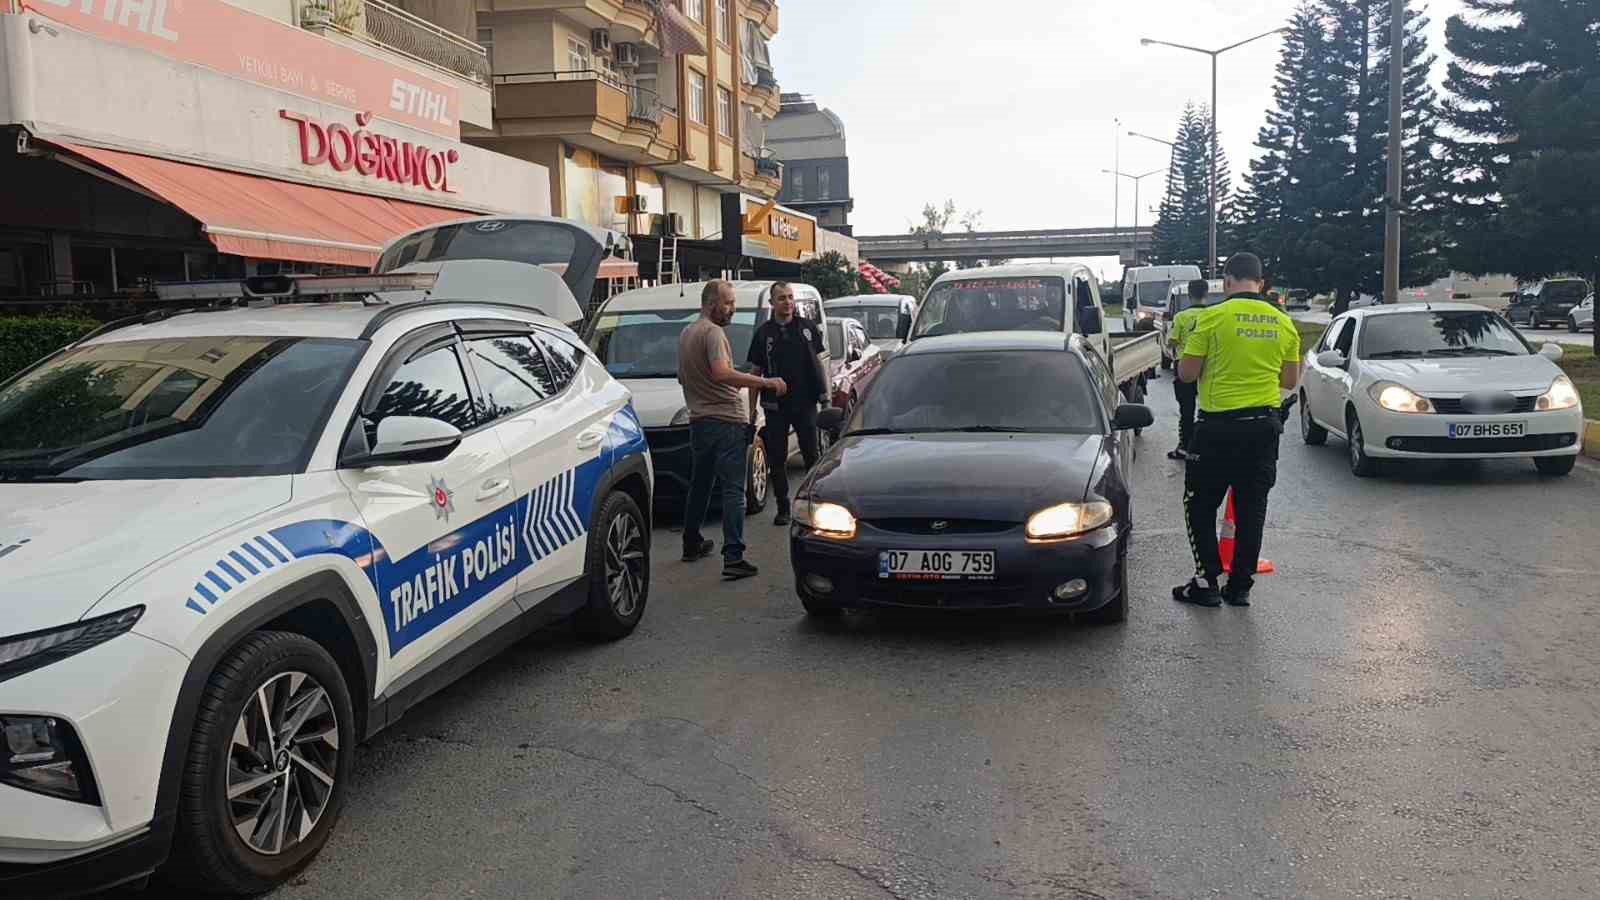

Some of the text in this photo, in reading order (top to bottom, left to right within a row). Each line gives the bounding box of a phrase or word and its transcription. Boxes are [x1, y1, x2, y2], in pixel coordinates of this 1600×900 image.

[389, 78, 453, 126] STIHL
[279, 109, 461, 193] DOĞRUYOL
[1456, 423, 1523, 436] 07 BHS 651
[391, 515, 516, 632] TRAFİK POLİSİ
[888, 552, 993, 572] 07 AOG 759
